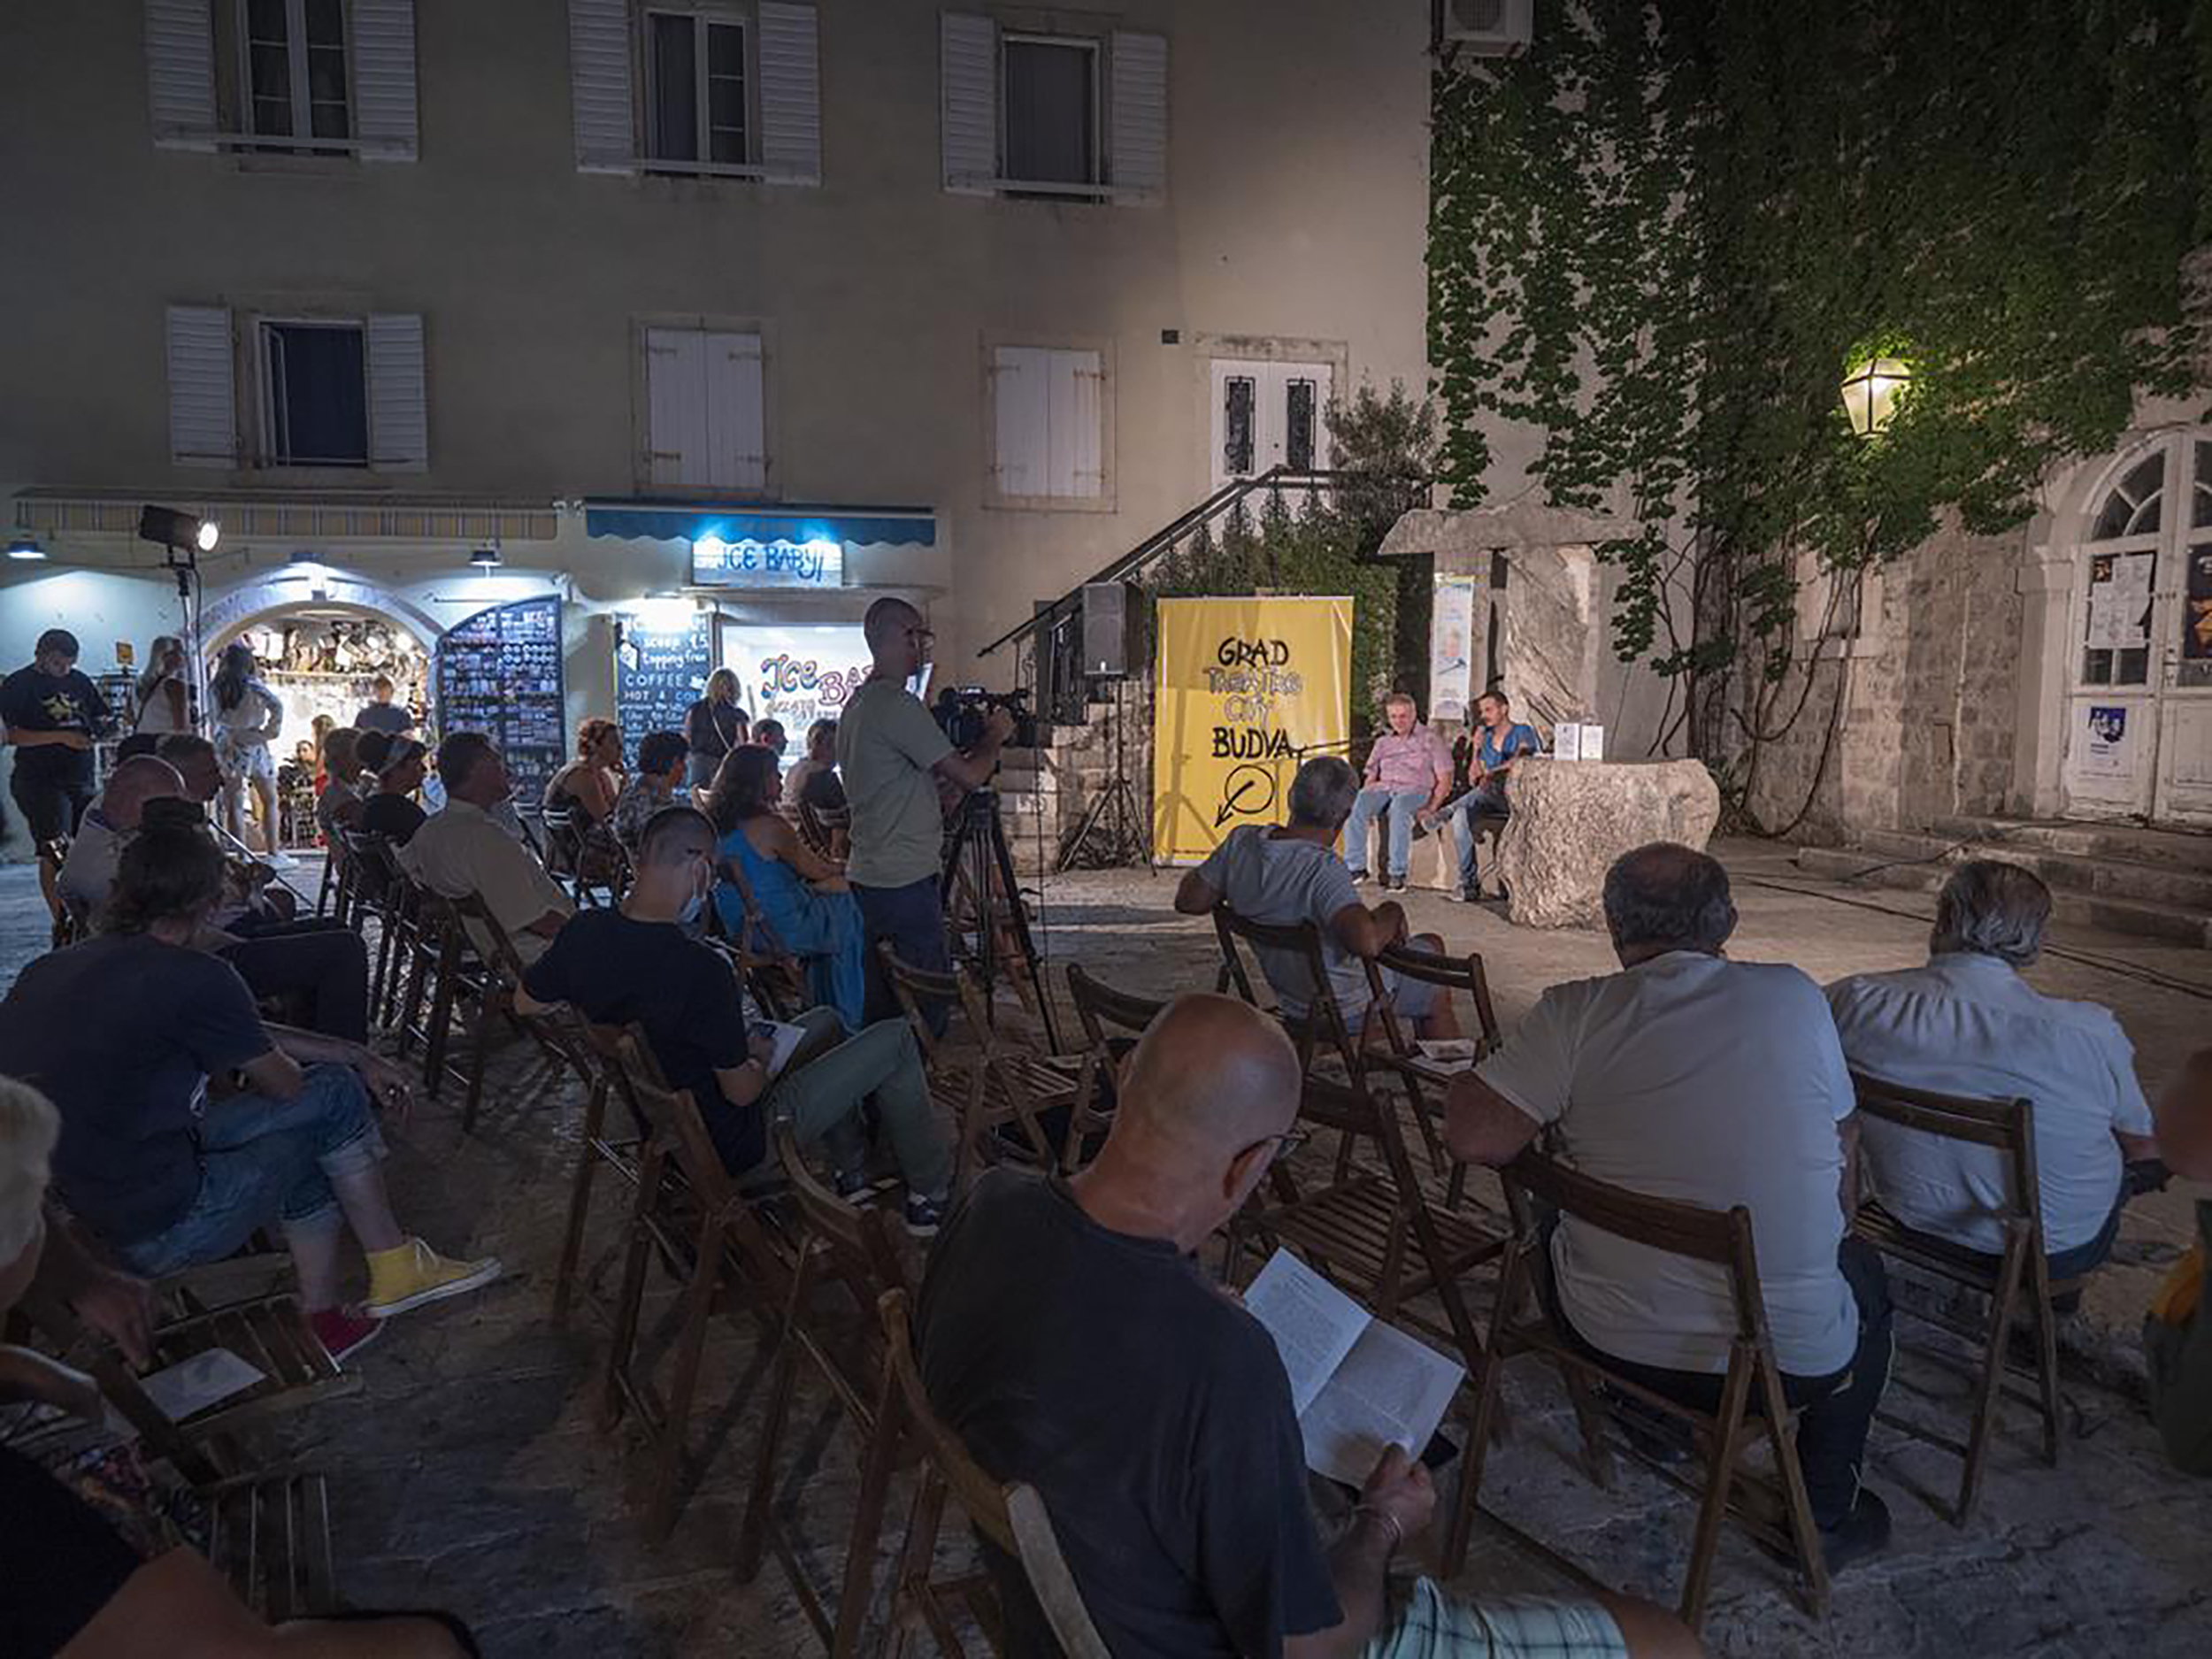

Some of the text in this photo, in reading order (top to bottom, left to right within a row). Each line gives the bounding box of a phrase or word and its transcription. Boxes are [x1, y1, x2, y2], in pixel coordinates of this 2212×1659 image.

[1217, 636, 1289, 668] GRAD
[624, 691, 649, 701] HOT
[626, 673, 685, 687] COFFEE
[818, 664, 874, 710] BA
[1211, 726, 1294, 759] BUDVA
